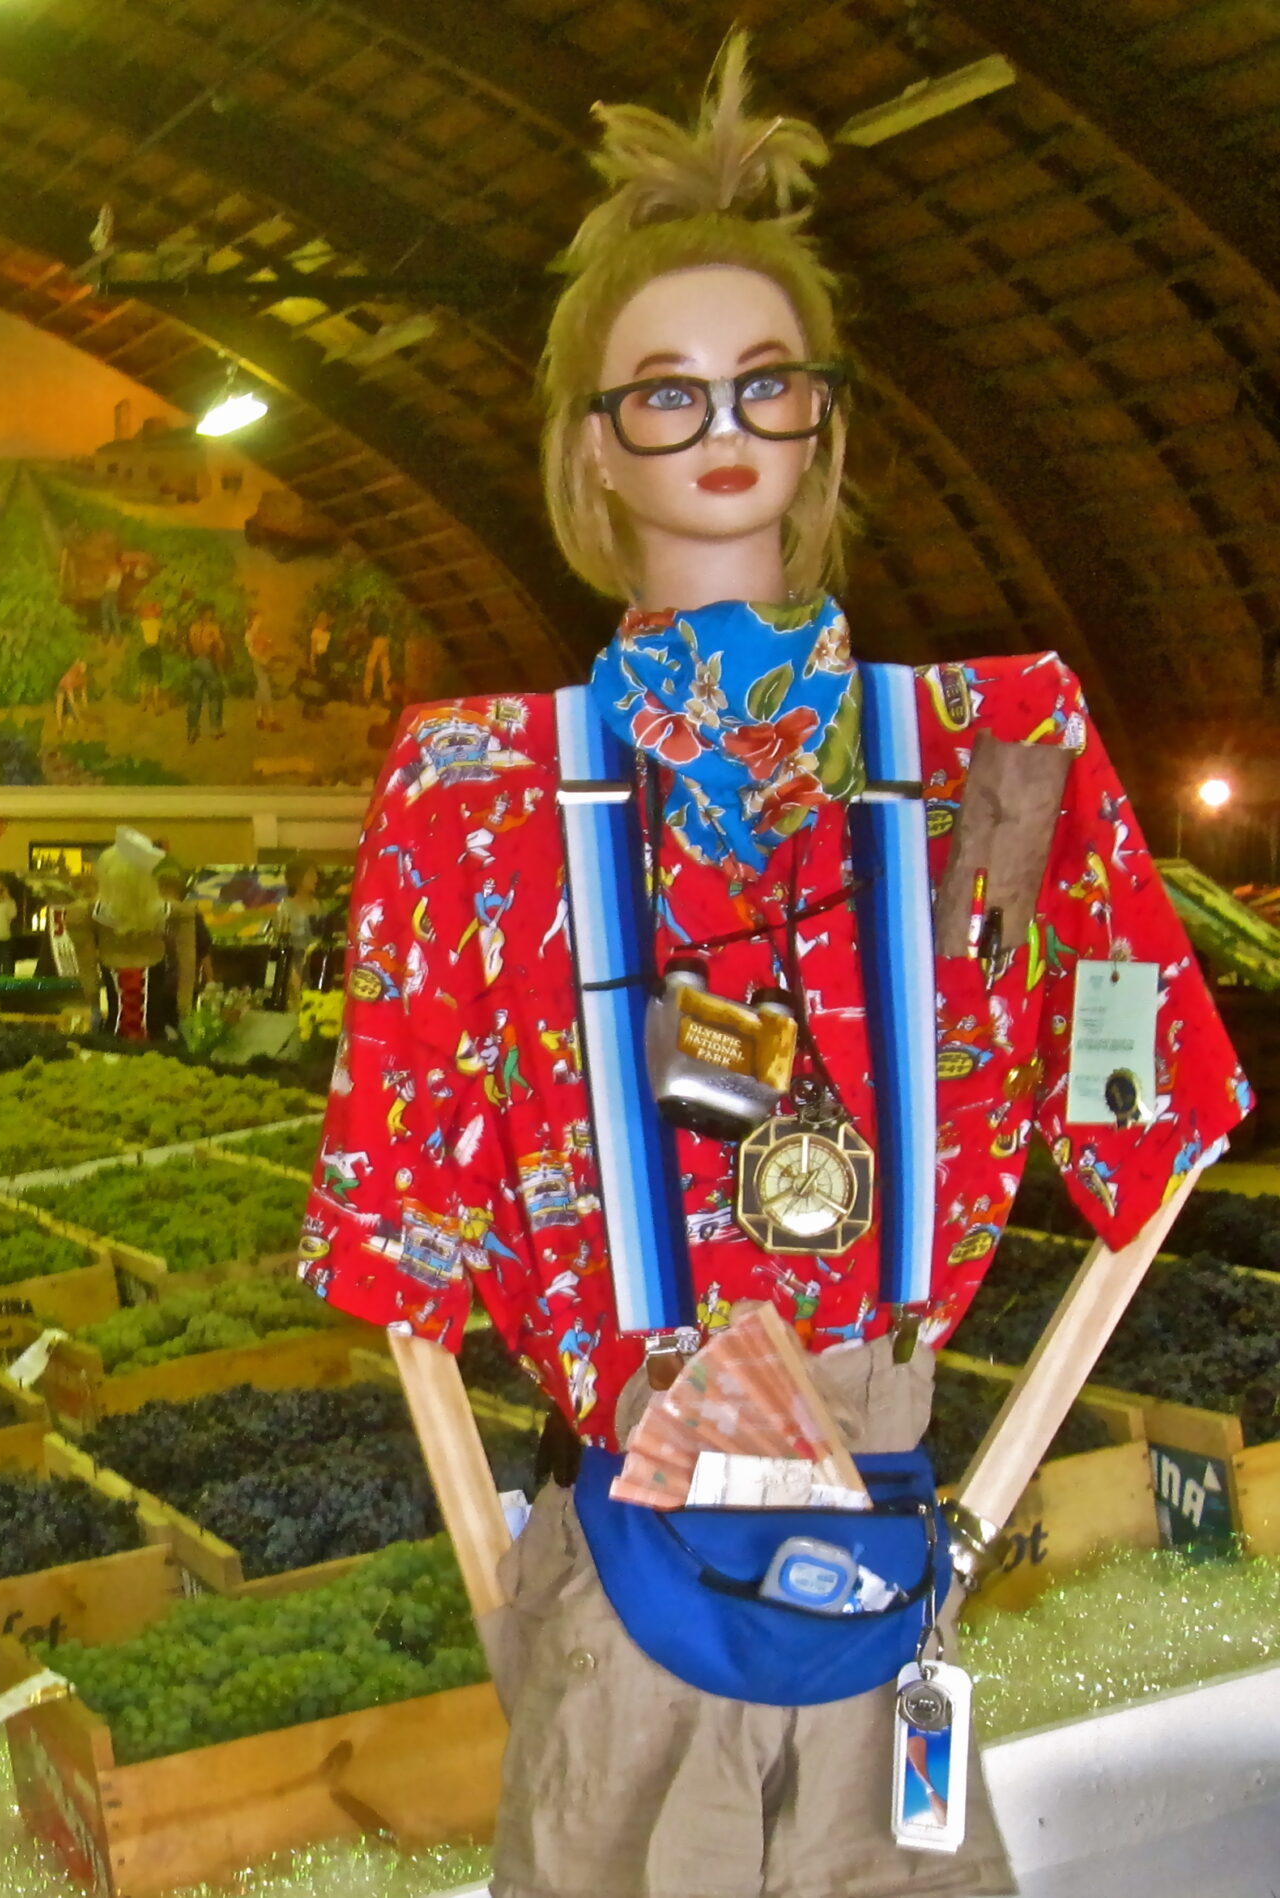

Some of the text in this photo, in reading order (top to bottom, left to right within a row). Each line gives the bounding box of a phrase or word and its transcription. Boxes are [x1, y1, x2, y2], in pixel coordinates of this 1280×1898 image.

[683, 1031, 745, 1062] NATIONAL
[688, 1022, 742, 1048] OLYMPIC
[697, 1047, 731, 1066] PARK
